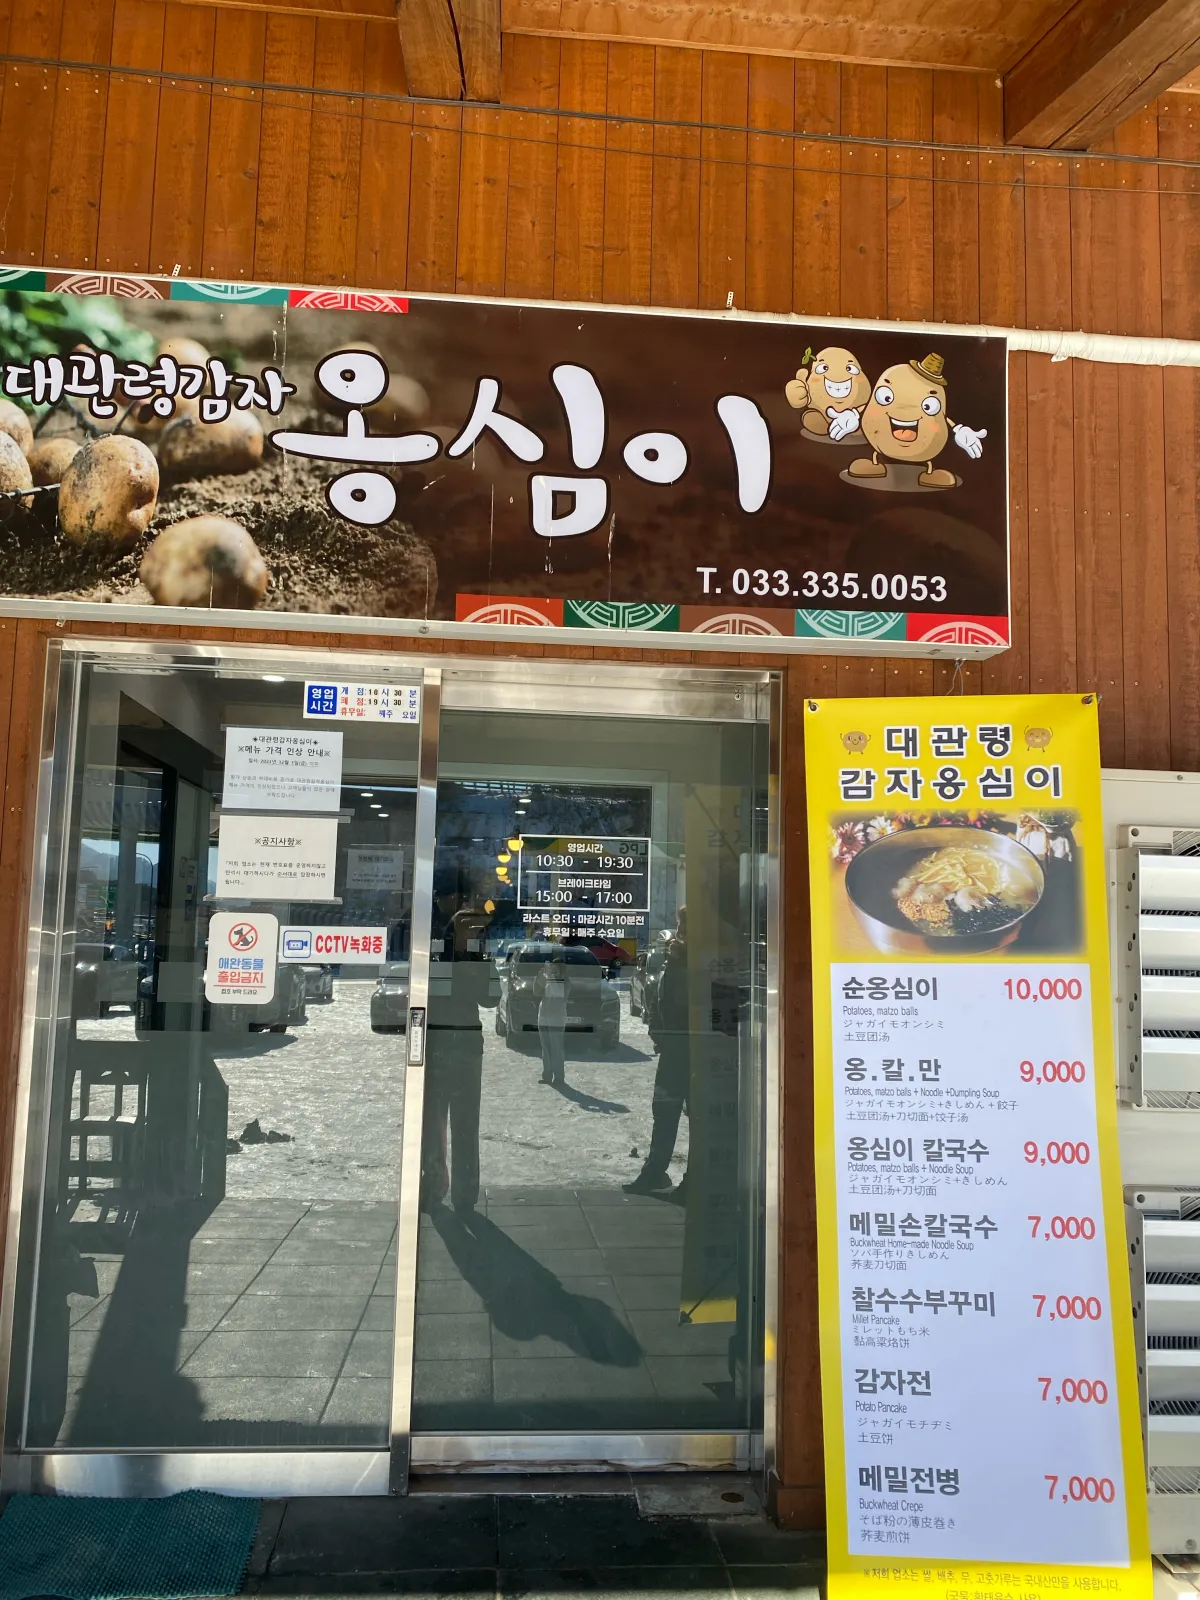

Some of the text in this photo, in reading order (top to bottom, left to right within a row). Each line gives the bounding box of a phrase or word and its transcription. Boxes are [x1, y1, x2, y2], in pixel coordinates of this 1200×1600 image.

[5, 352, 772, 537] 대관령감자 옹심이
[696, 567, 948, 602] T. 033.335.0053
[311, 687, 334, 700] 영업
[381, 688, 390, 697] 시
[394, 689, 402, 697] 30
[409, 689, 417, 698] 분
[310, 701, 334, 712] 시간
[368, 698, 378, 706] 19
[381, 698, 390, 707] 시
[409, 699, 417, 709] 분
[402, 711, 417, 720] 요일
[265, 746, 282, 756] 가격
[286, 747, 303, 757] 인상
[567, 843, 604, 853] 영업시간
[536, 854, 574, 867] 10:30
[597, 856, 634, 869] 19:30
[557, 878, 612, 888] 브레이크타임
[535, 890, 573, 903] 15:00
[596, 891, 633, 904] 17:00
[522, 913, 550, 923] 라스트
[552, 914, 571, 924] 오더
[577, 915, 614, 925] 마감시간
[615, 915, 645, 926] 10분전
[543, 927, 571, 938] 휴무일
[577, 927, 596, 938] 매주
[597, 928, 625, 938] 수요일
[315, 934, 383, 954] CCTV녹화중
[218, 957, 264, 969] 애완동물
[217, 971, 264, 984] 출입금지
[842, 976, 938, 1001] 순옹심이
[1003, 978, 1082, 1002] 10,000
[843, 1006, 918, 1017] Potatoes, matzo balls
[844, 1031, 890, 1042] 土豆团汤
[1019, 1060, 1086, 1085] 9,000
[845, 1086, 874, 1097] Potatoes,
[875, 1087, 894, 1096] matzo
[896, 1087, 911, 1097] balls
[920, 1087, 943, 1097] Noodle
[982, 1088, 1000, 1099] Soup
[847, 1136, 990, 1163] 옹심이 칼국수
[1023, 1141, 1090, 1166] 9,000
[847, 1162, 878, 1174] Potatoes,
[880, 1163, 901, 1173] matzo
[902, 1163, 919, 1173] balls
[929, 1164, 953, 1174] Noodle
[955, 1164, 974, 1175] Soup
[849, 1212, 998, 1239] 메밀손칼국수
[1027, 1215, 1096, 1241] 7,000
[850, 1237, 974, 1251] Buckwheat Home-made Noodle Soup
[851, 1286, 996, 1317] 찰수수부꾸미
[1032, 1294, 1102, 1321] 7,000
[852, 1313, 900, 1326] Millet Pancake
[854, 1368, 932, 1396] 감자전
[1037, 1377, 1108, 1404] 7,000
[855, 1400, 907, 1413] Potato Pancake
[858, 1432, 893, 1445] 土豆饼
[858, 1465, 960, 1496] 메밀전병
[1044, 1474, 1116, 1504] 7,000
[859, 1498, 923, 1513] Buckwheat Crepe
[892, 1567, 919, 1582] 업소는
[976, 1573, 1022, 1588] 고춧가루는
[1024, 1575, 1070, 1590] 국내산만을
